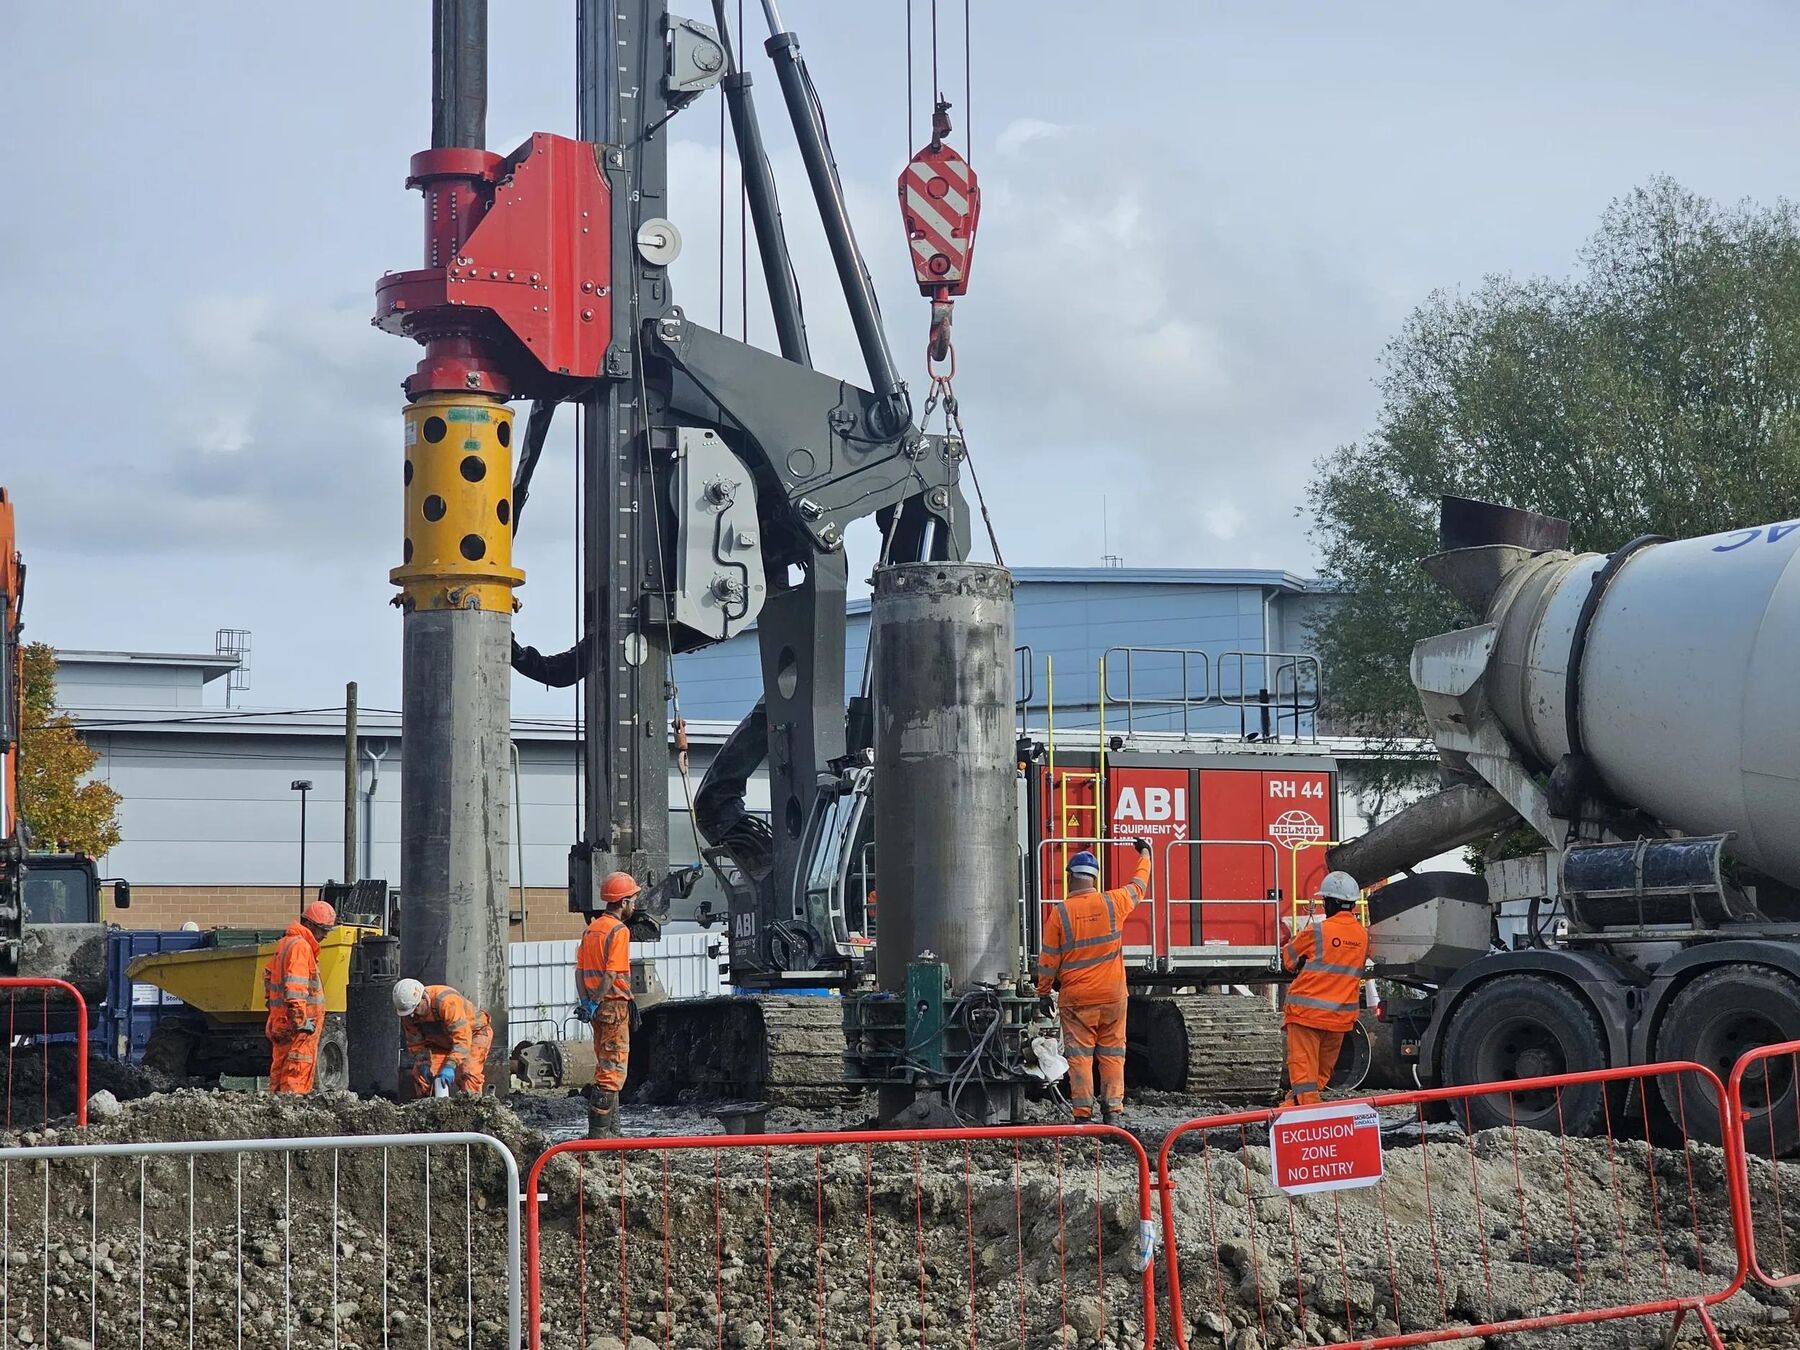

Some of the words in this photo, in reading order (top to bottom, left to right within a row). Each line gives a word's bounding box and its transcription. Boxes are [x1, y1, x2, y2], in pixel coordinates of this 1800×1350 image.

[631, 86, 640, 98] 7
[632, 190, 640, 202] 6
[631, 396, 639, 408] 4
[632, 500, 639, 513] 3
[632, 713, 639, 725] 1
[1269, 780, 1296, 798] RH
[1300, 781, 1324, 799] 44
[1113, 786, 1186, 821] ABI
[1113, 824, 1171, 834] EQUIPMENT
[1273, 826, 1320, 835] DELMAG
[735, 912, 756, 938] ABI
[1282, 1123, 1354, 1144] EXCLUSION
[1301, 1144, 1337, 1161] ZONE
[1288, 1168, 1309, 1181] NO
[1312, 1161, 1354, 1178] ENTRY
